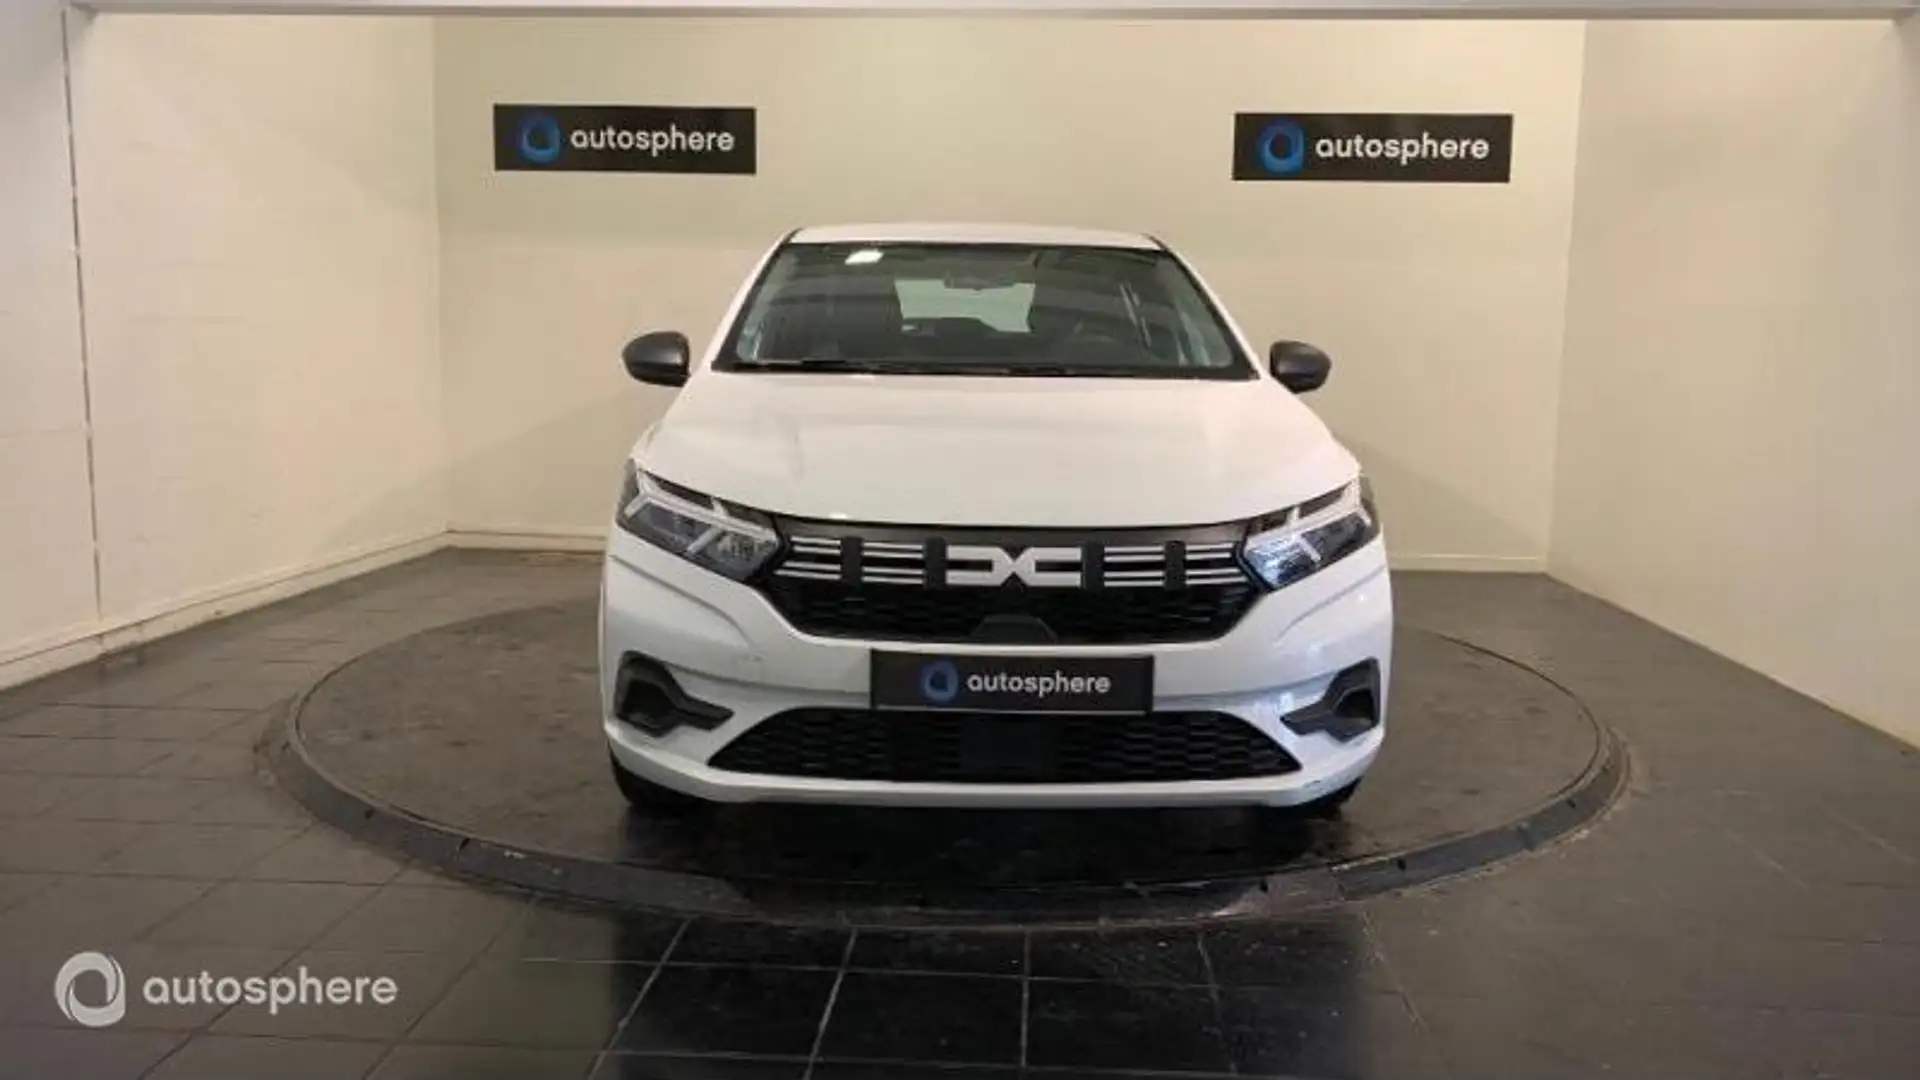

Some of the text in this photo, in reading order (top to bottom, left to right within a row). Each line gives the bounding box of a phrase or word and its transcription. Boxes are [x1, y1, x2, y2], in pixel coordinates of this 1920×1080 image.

[570, 123, 735, 158] autosphere
[1315, 131, 1490, 166] autosphere
[967, 669, 1112, 698] autosphere
